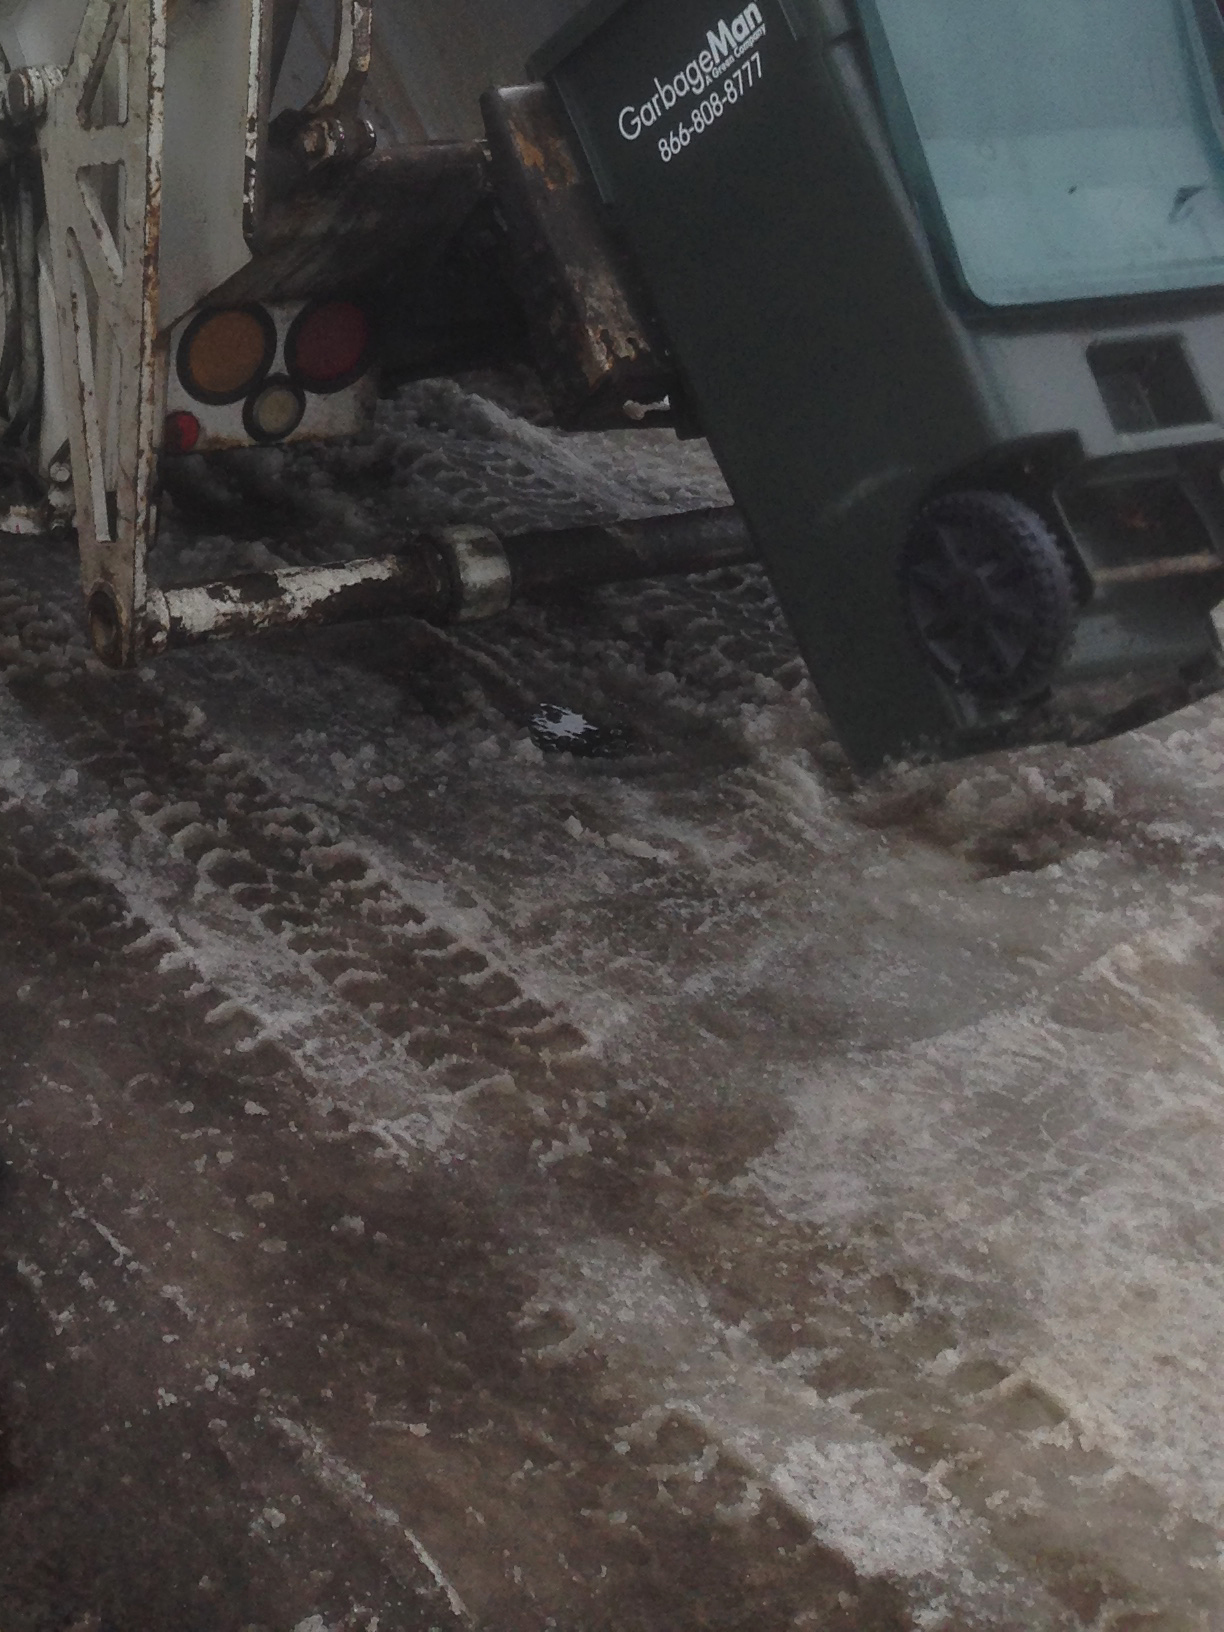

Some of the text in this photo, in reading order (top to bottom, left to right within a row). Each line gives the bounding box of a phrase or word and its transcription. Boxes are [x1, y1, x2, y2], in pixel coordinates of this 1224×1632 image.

[618, 1, 763, 141] GarbageMan
[657, 51, 763, 163] 866-808-8777
[705, 74, 714, 87] A
[733, 22, 767, 59] Company
